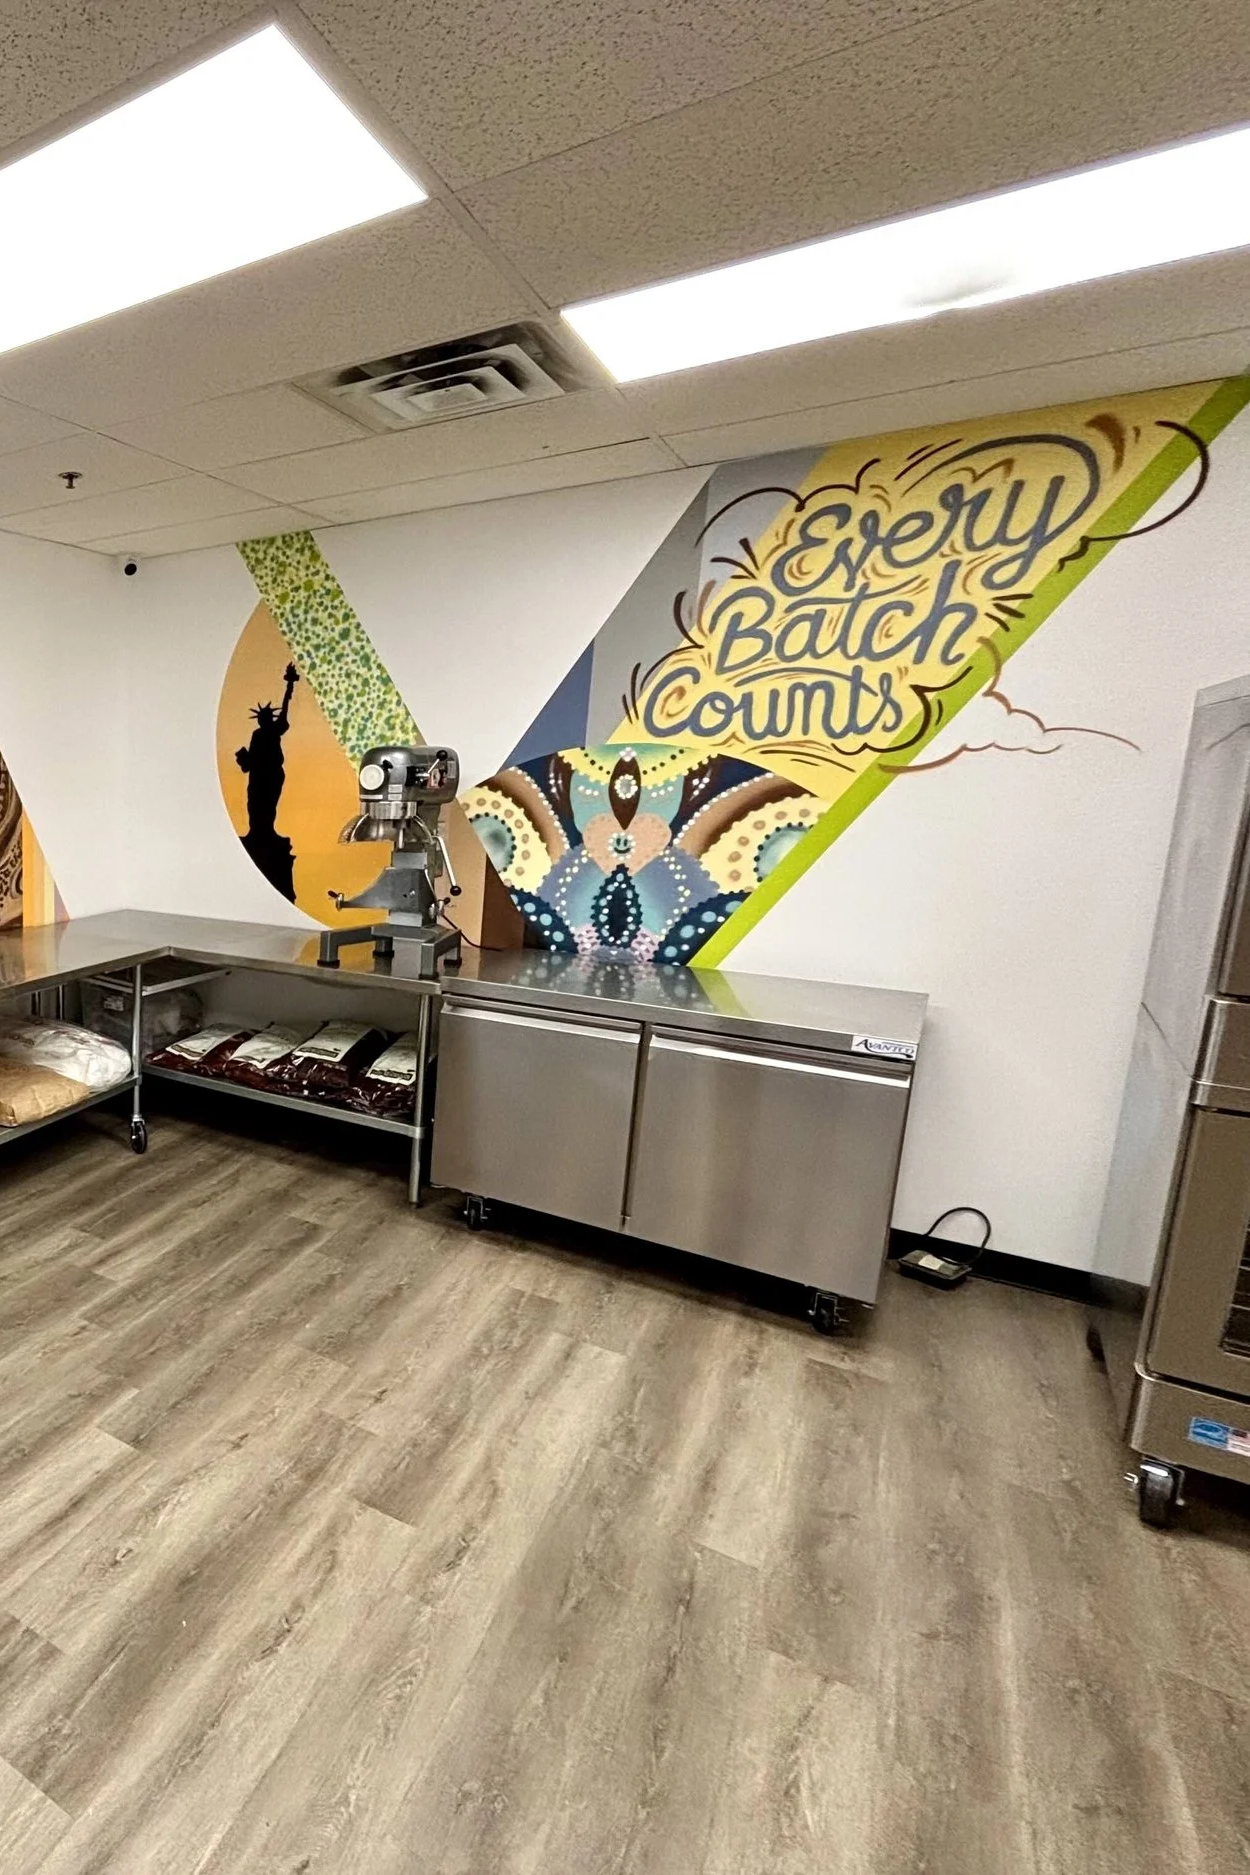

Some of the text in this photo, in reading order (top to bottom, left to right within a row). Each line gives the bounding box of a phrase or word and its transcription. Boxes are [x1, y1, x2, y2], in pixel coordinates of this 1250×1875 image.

[770, 433, 1100, 598] Every
[708, 558, 981, 674] Batch
[644, 664, 905, 742] Counts
